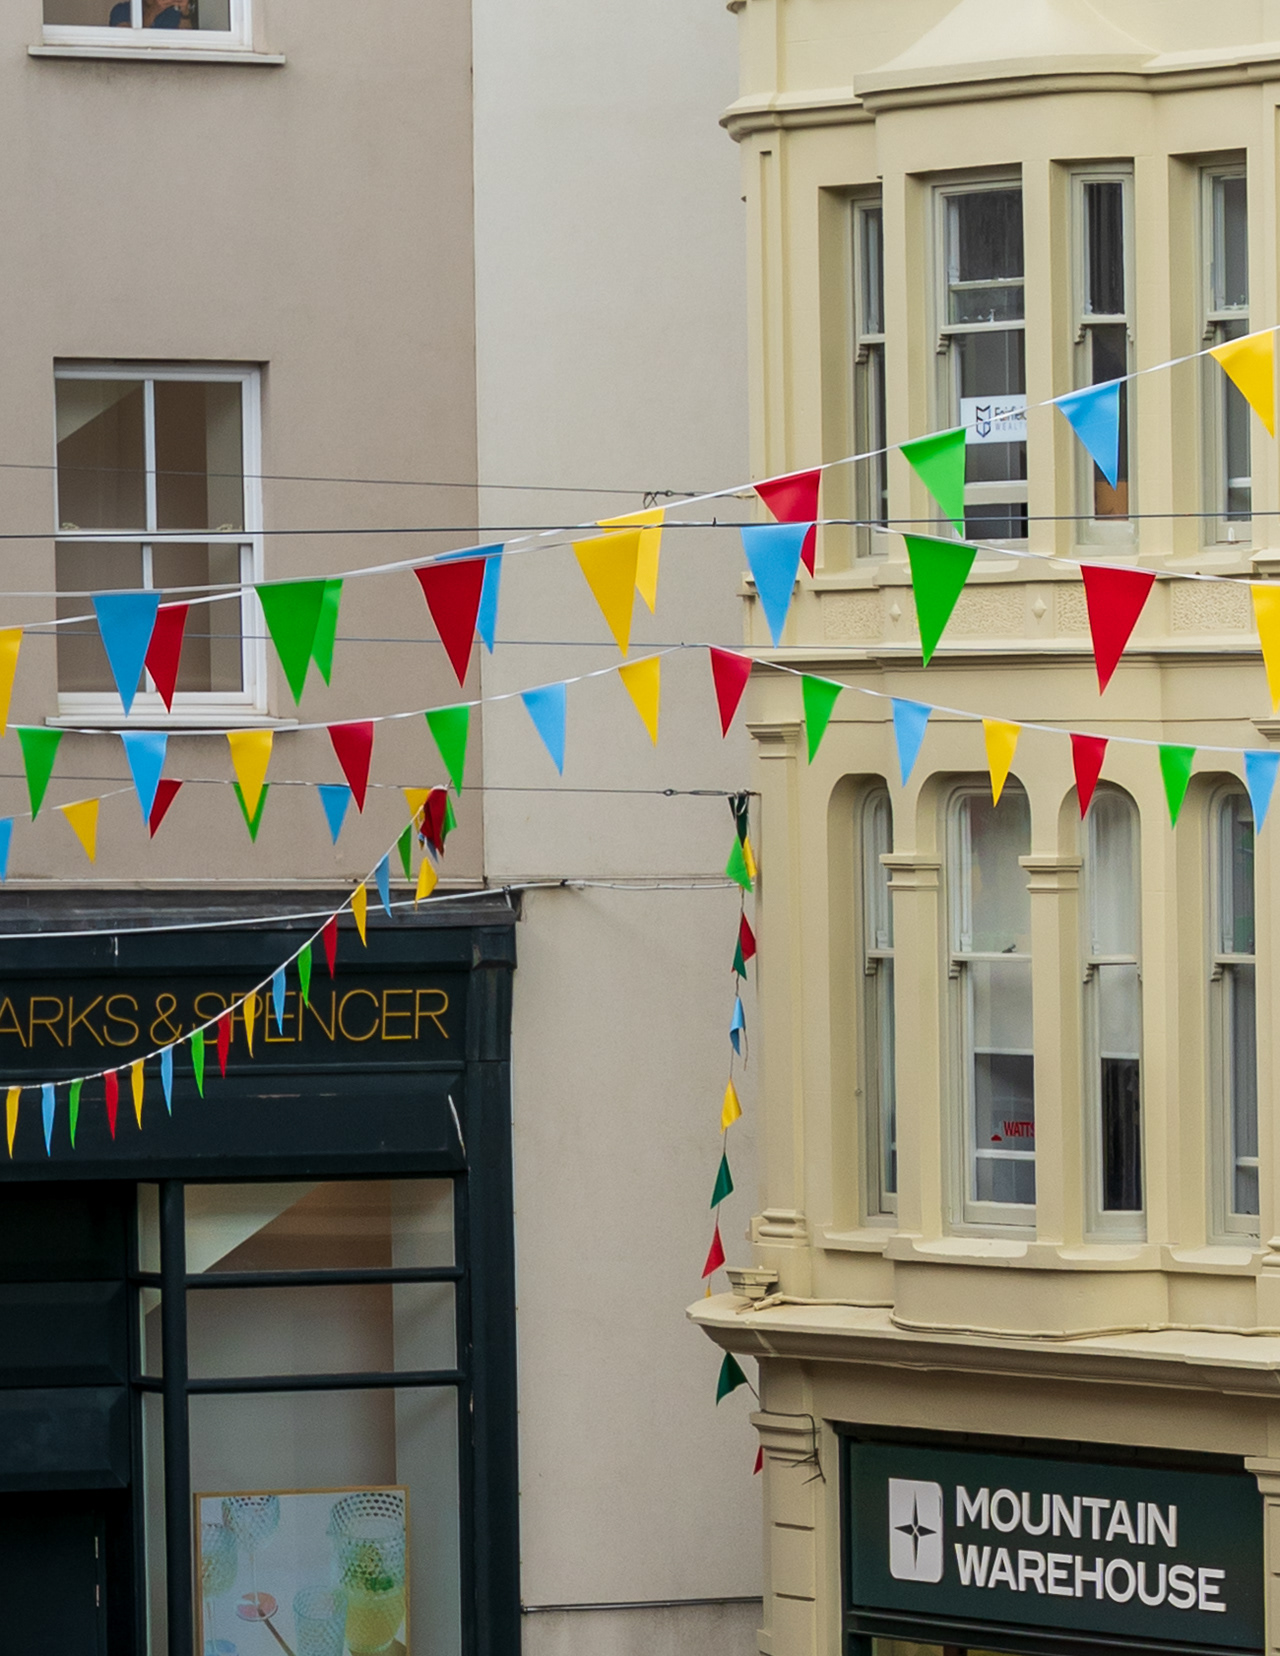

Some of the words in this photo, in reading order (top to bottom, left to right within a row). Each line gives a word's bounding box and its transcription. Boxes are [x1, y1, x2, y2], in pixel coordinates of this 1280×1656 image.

[150, 993, 184, 1045] &
[195, 989, 450, 1045] SPENCER
[955, 1485, 1178, 1549] MOUNTAIN
[954, 1543, 1227, 1613] WAREHOUSE
